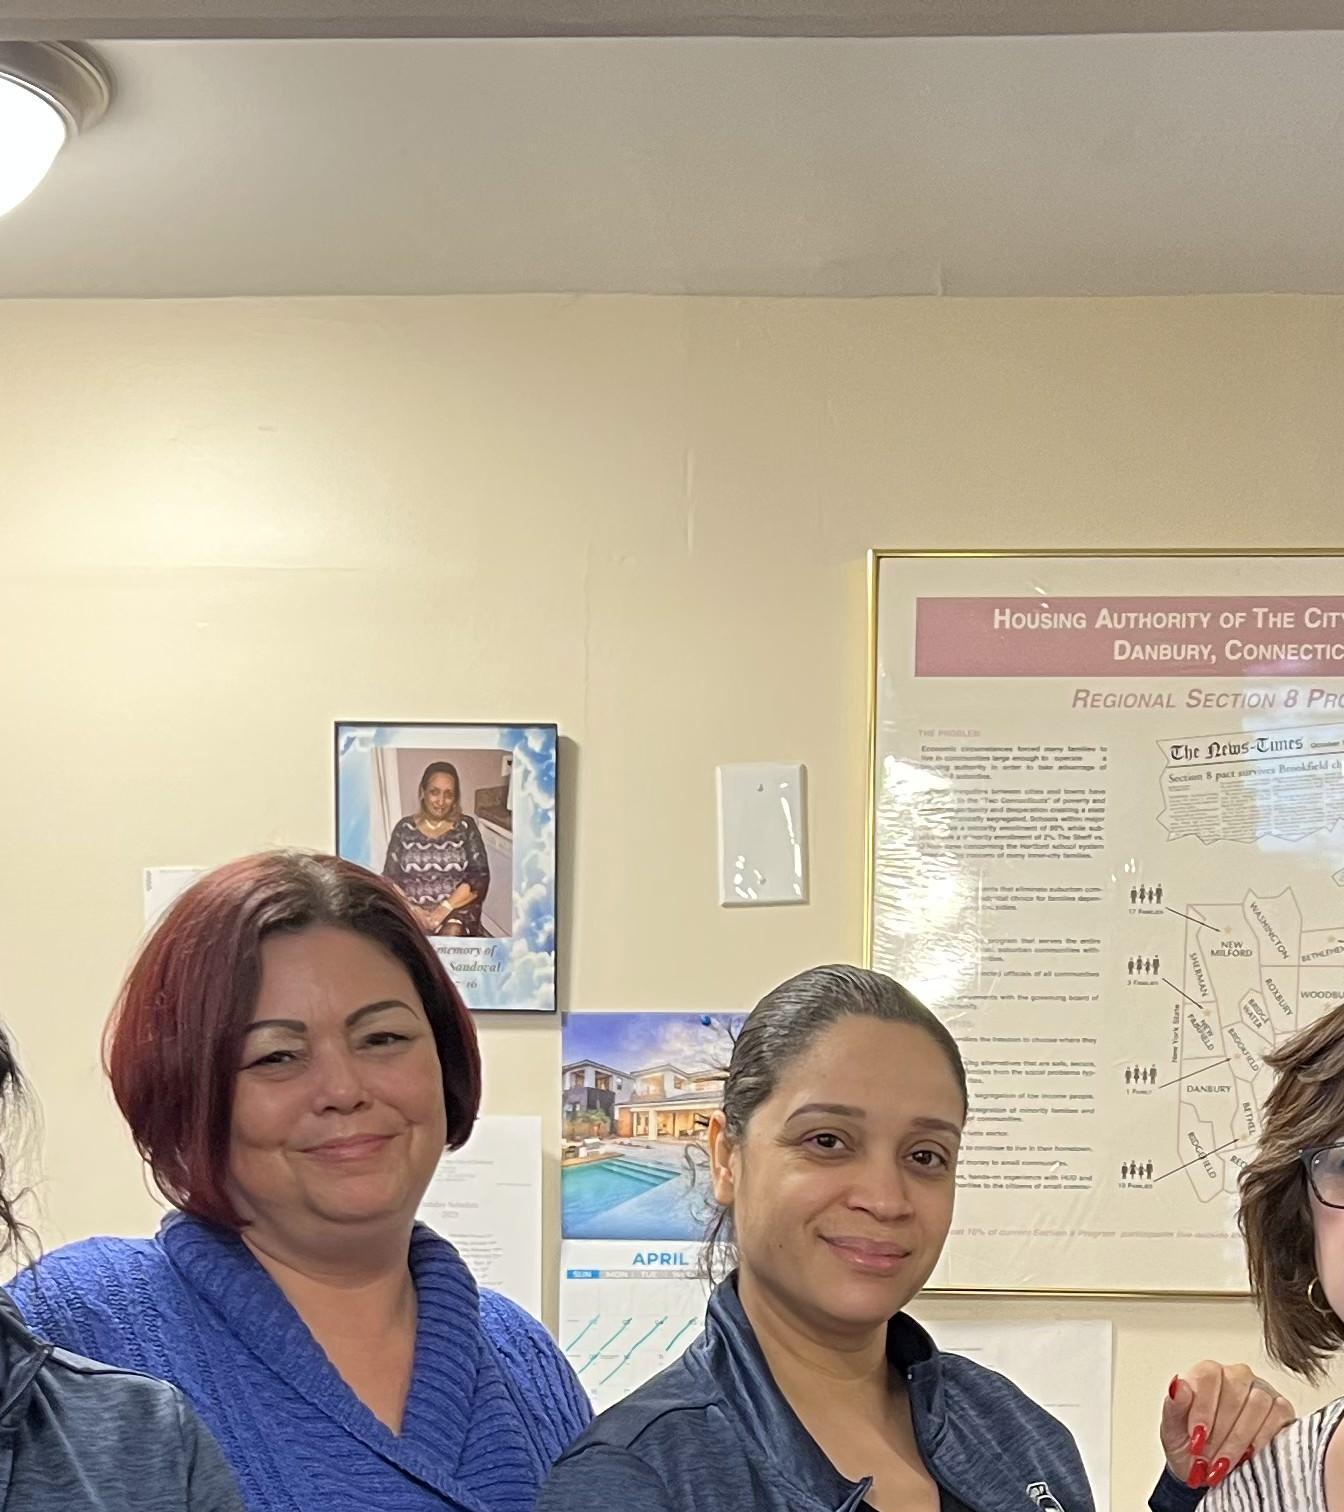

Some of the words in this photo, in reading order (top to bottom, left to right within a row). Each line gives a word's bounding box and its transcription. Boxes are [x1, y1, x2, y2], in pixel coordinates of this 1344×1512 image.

[993, 608, 1087, 629] HOUSING
[1094, 608, 1211, 629] AUTHORITY
[1219, 612, 1246, 628] OF
[1252, 608, 1295, 628] THE
[1113, 640, 1217, 664] DANBURY,
[1072, 688, 1177, 709] REGIONAL
[1186, 688, 1276, 708] SECTION
[1284, 690, 1298, 708] 8
[1170, 744, 1199, 761] The
[1205, 737, 1304, 759] News-Times
[1168, 774, 1203, 784] Section
[1206, 771, 1211, 780] 8
[1216, 770, 1235, 783] pact
[1238, 766, 1275, 778] survives
[1279, 761, 1328, 774] Brookfield
[1249, 902, 1290, 960] WASHINGTON
[436, 945, 482, 955] memory
[484, 945, 497, 957] of
[1210, 949, 1253, 957] MILFORD
[1221, 941, 1244, 949] NEW
[1189, 952, 1210, 998] SHERMAN
[1265, 978, 1294, 1016] ROXBURY
[1243, 1004, 1263, 1029] WATER
[1248, 997, 1270, 1025] BRIDGE
[1187, 1013, 1215, 1051] FAIRFIELD
[1199, 1019, 1213, 1038] NEW
[1227, 1028, 1259, 1072] BROOKFIELD
[1243, 1102, 1256, 1135] BETHEL
[632, 1253, 688, 1265] APRIL
